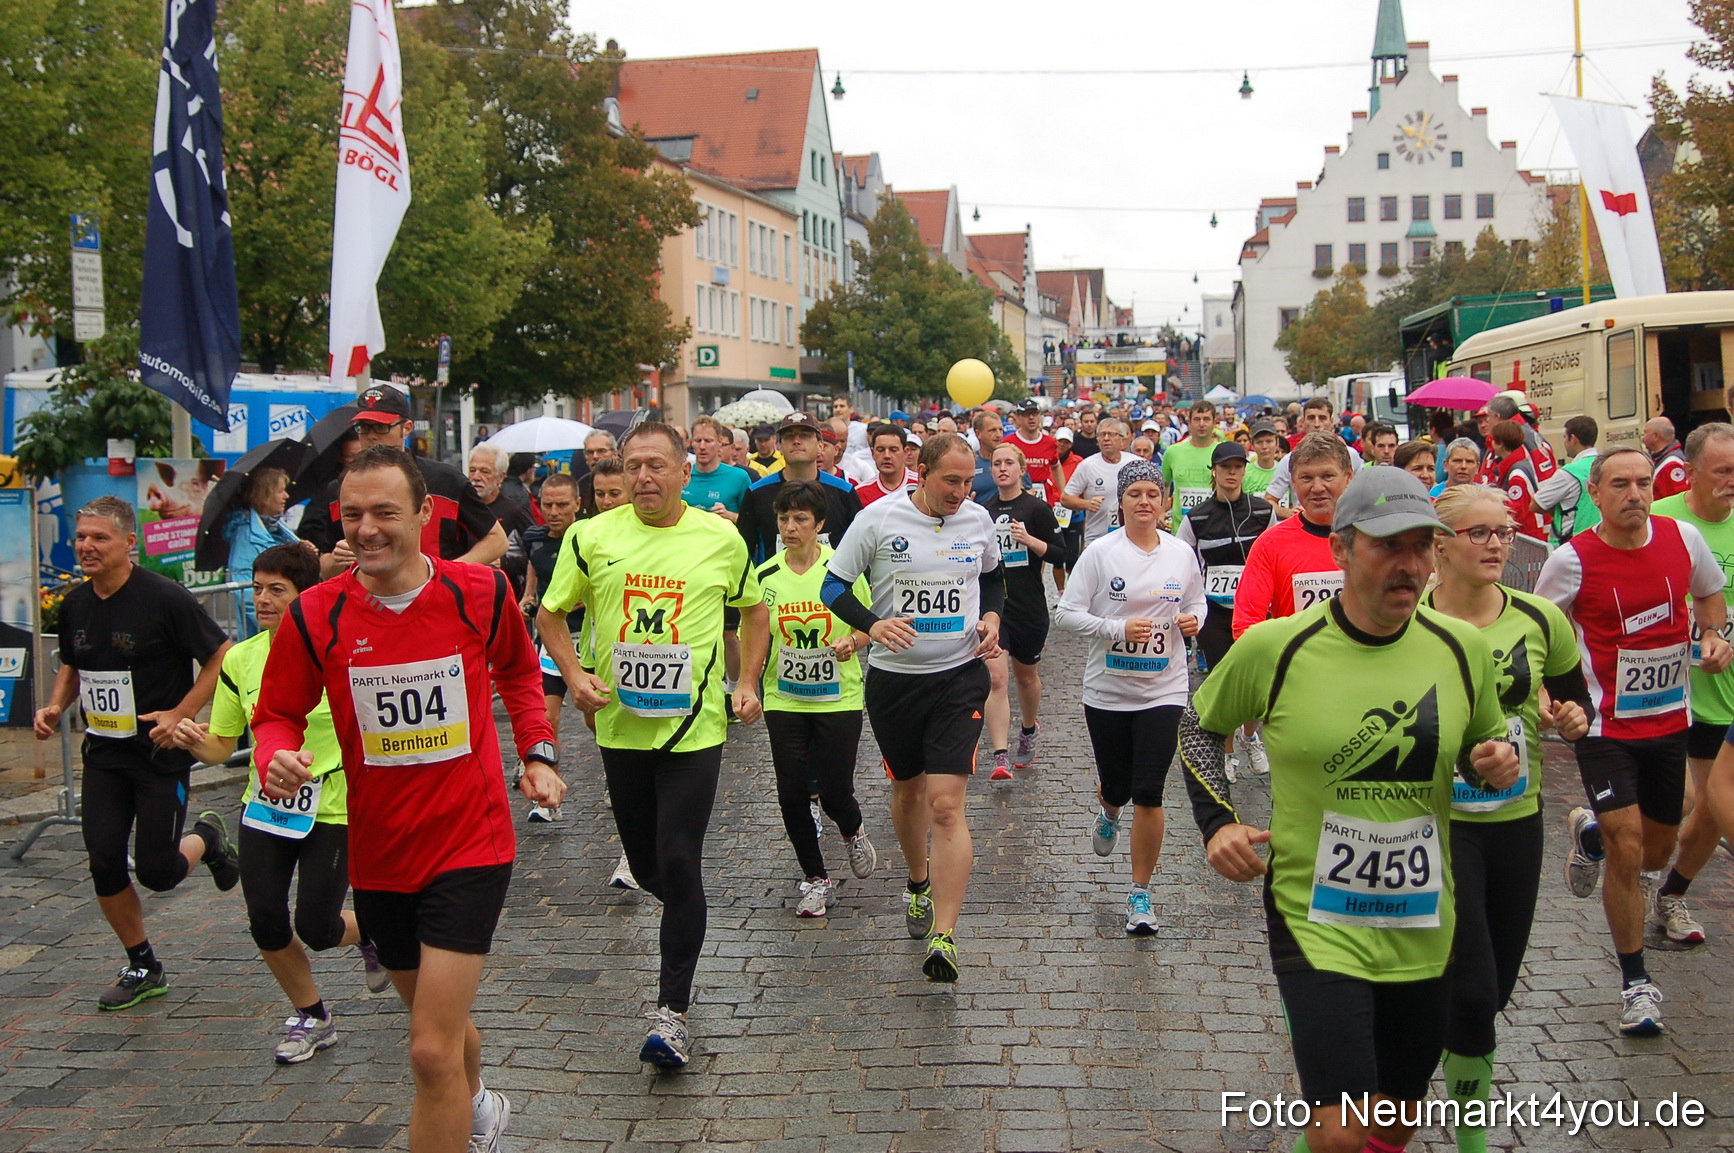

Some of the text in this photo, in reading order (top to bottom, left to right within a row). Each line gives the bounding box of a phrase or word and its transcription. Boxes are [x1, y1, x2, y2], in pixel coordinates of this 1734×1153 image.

[344, 149, 399, 192] BÖGL
[700, 347, 716, 365] D
[1104, 366, 1135, 374] START
[1530, 351, 1580, 378] Bayerisches
[1385, 494, 1408, 502] GOSSEN
[170, 527, 198, 540] STIMM
[182, 560, 195, 570] UN
[624, 573, 686, 590] Müller
[895, 578, 955, 587] PARTL Neumarkt
[1294, 577, 1344, 588] PARTL Neum
[901, 588, 960, 615] 2646
[1109, 591, 1128, 599] PARTL
[633, 609, 666, 634] M
[1637, 611, 1658, 626] DEHN
[352, 646, 373, 655] erima
[613, 648, 677, 660] PARTL Neumarkt
[780, 647, 829, 661] PARTL Neumarkt
[1619, 655, 1646, 664] PARTL
[1647, 651, 1679, 663] Neumarkt
[783, 659, 834, 682] 2349
[1112, 658, 1162, 670] Margaretha
[352, 669, 446, 687] PARTL Neumarkt
[619, 661, 684, 690] 2027
[1625, 660, 1682, 692] 2307
[788, 684, 828, 694] Rosmarie
[87, 687, 120, 713] 150
[375, 685, 447, 728] 504
[636, 696, 665, 707] Peter
[1641, 696, 1665, 707] Peter
[93, 716, 118, 729] Thomas
[381, 731, 448, 752] Bernhard
[1323, 721, 1381, 776] GOSSEN
[1336, 786, 1433, 801] METRAWATT
[270, 812, 289, 825] Rita
[1324, 822, 1419, 845] PARTL Neumarkt
[1327, 842, 1431, 889] 2459
[1345, 897, 1408, 914] Herbert
